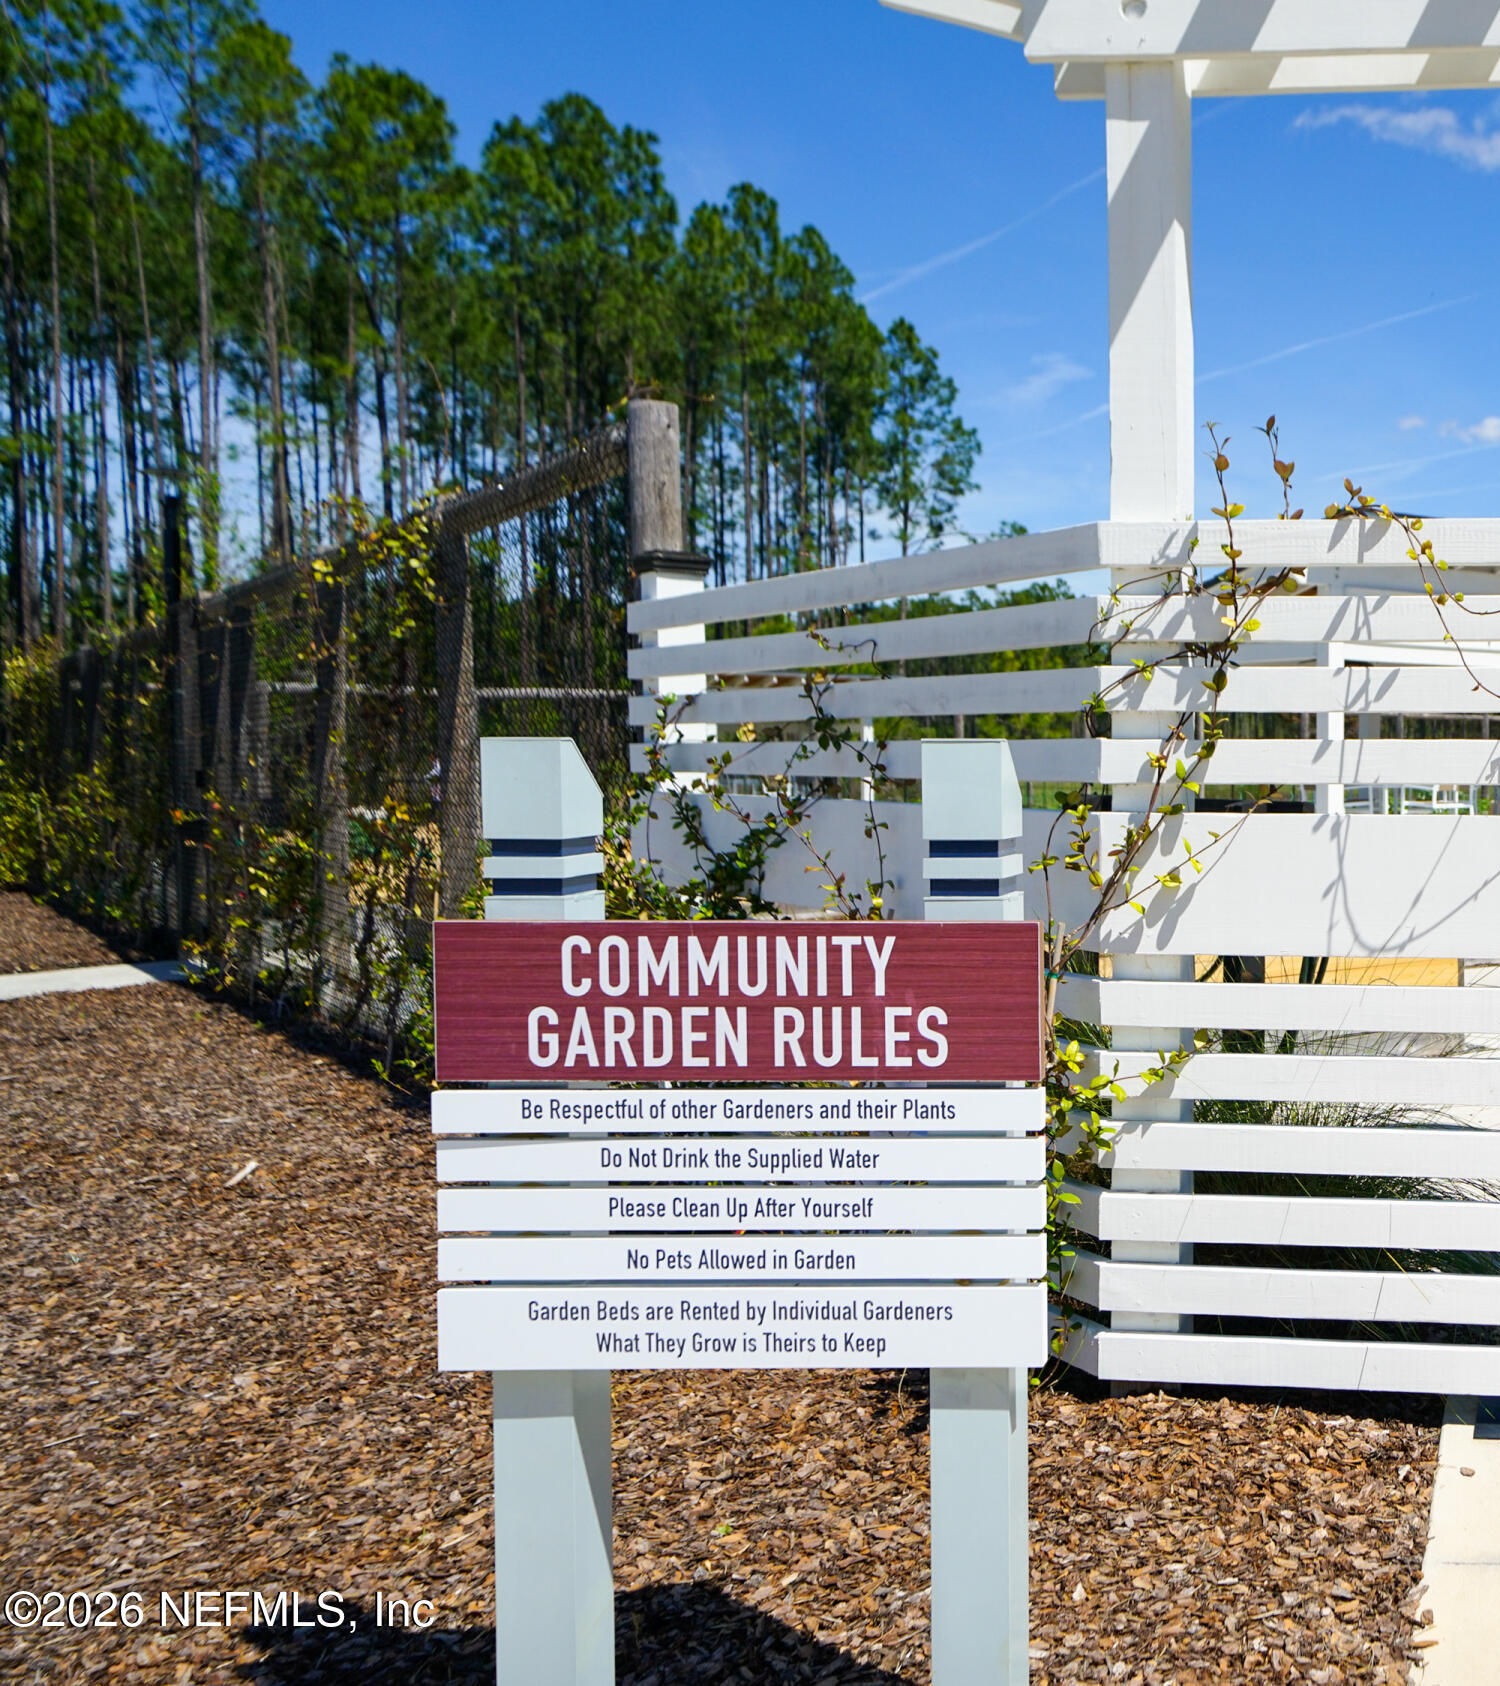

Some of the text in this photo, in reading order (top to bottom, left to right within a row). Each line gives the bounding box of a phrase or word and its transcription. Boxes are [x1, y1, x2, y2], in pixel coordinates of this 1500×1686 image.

[561, 934, 897, 997] COMMUNITY
[527, 1005, 949, 1068] GARDEN RULES
[521, 1098, 956, 1125] Be Respectful of other Gardeners and their Plants
[600, 1147, 880, 1174] Do Not Drink the Supplied Water
[608, 1196, 874, 1224] Please Clean Up After Yourself
[627, 1248, 856, 1270] No Pets Allowed in Garden
[528, 1299, 953, 1327] Garden Beds are Rented by Individual Gardeners
[595, 1331, 886, 1359] What They Grow is Theirs to Keep
